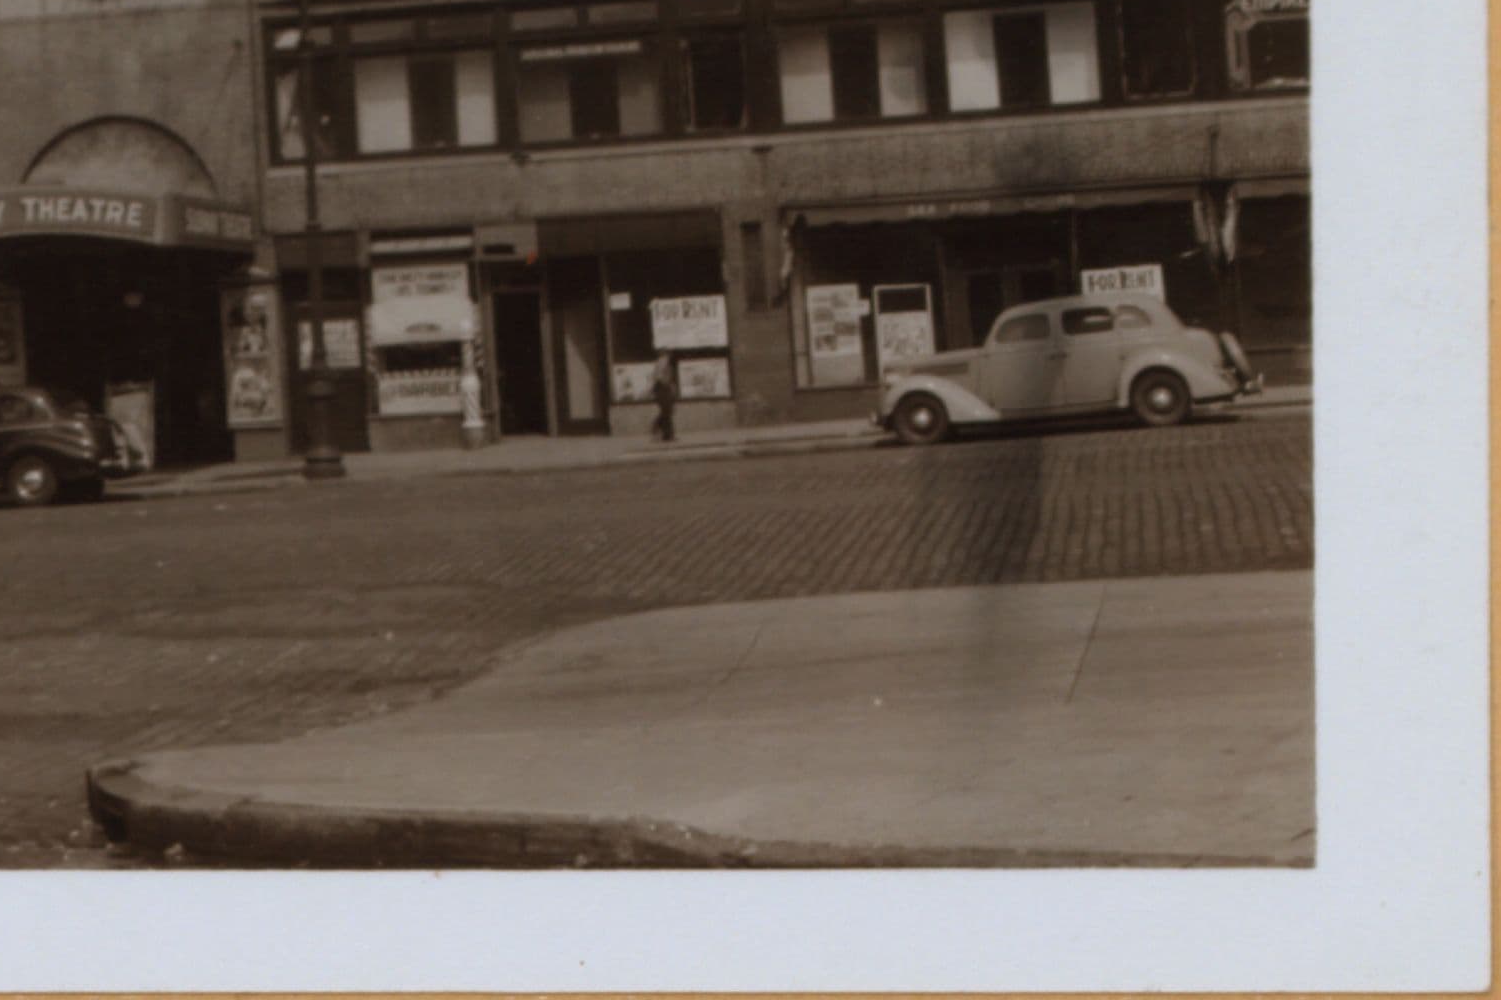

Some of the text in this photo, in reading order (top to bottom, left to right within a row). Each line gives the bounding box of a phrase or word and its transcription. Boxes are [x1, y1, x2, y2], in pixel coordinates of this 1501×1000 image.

[19, 197, 144, 228] THEATRE
[1087, 269, 1156, 293] FOR RENT
